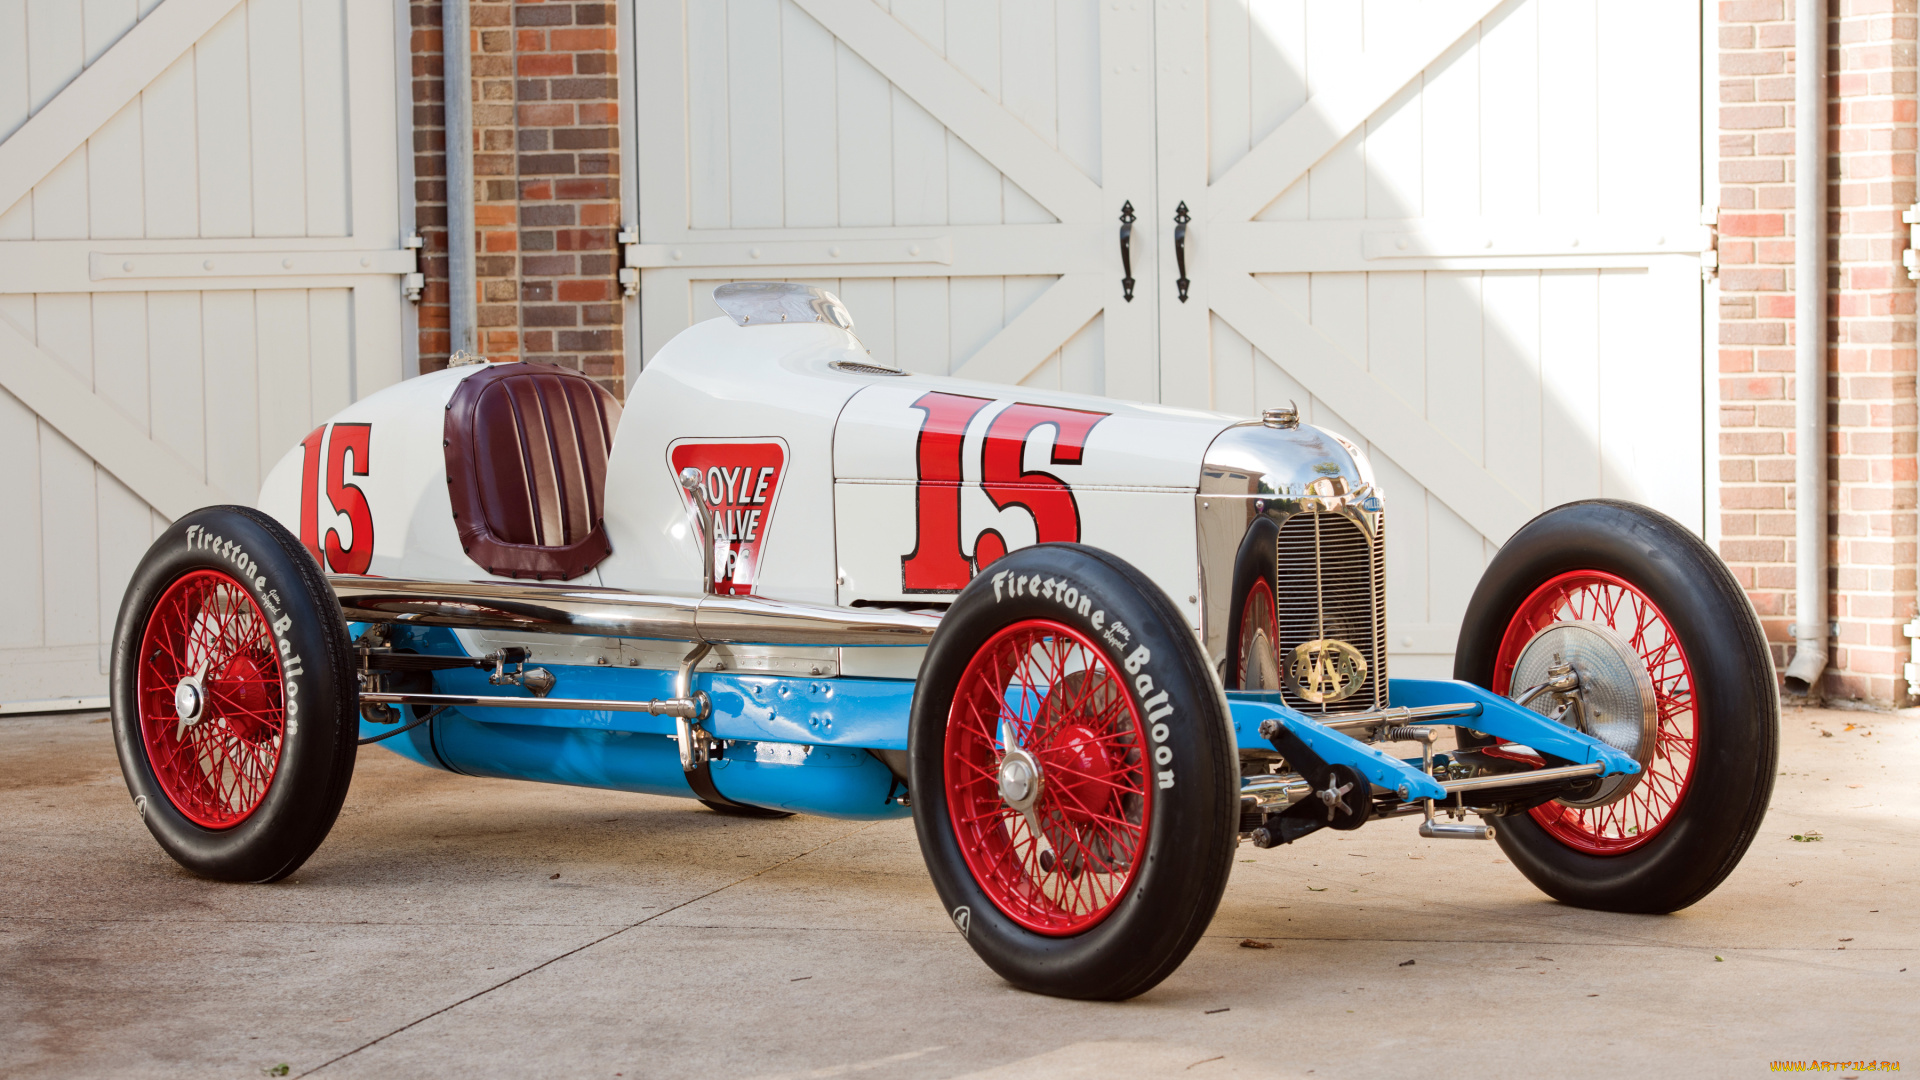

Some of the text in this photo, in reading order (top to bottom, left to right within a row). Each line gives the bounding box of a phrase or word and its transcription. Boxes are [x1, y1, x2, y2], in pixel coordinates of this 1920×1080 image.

[299, 422, 373, 576] 15
[694, 510, 762, 543] ALVE
[901, 391, 1112, 594] 15
[185, 524, 304, 736] Firestone Balloon
[990, 568, 1176, 790] Firestone Balloon
[1289, 647, 1360, 696] AAA
